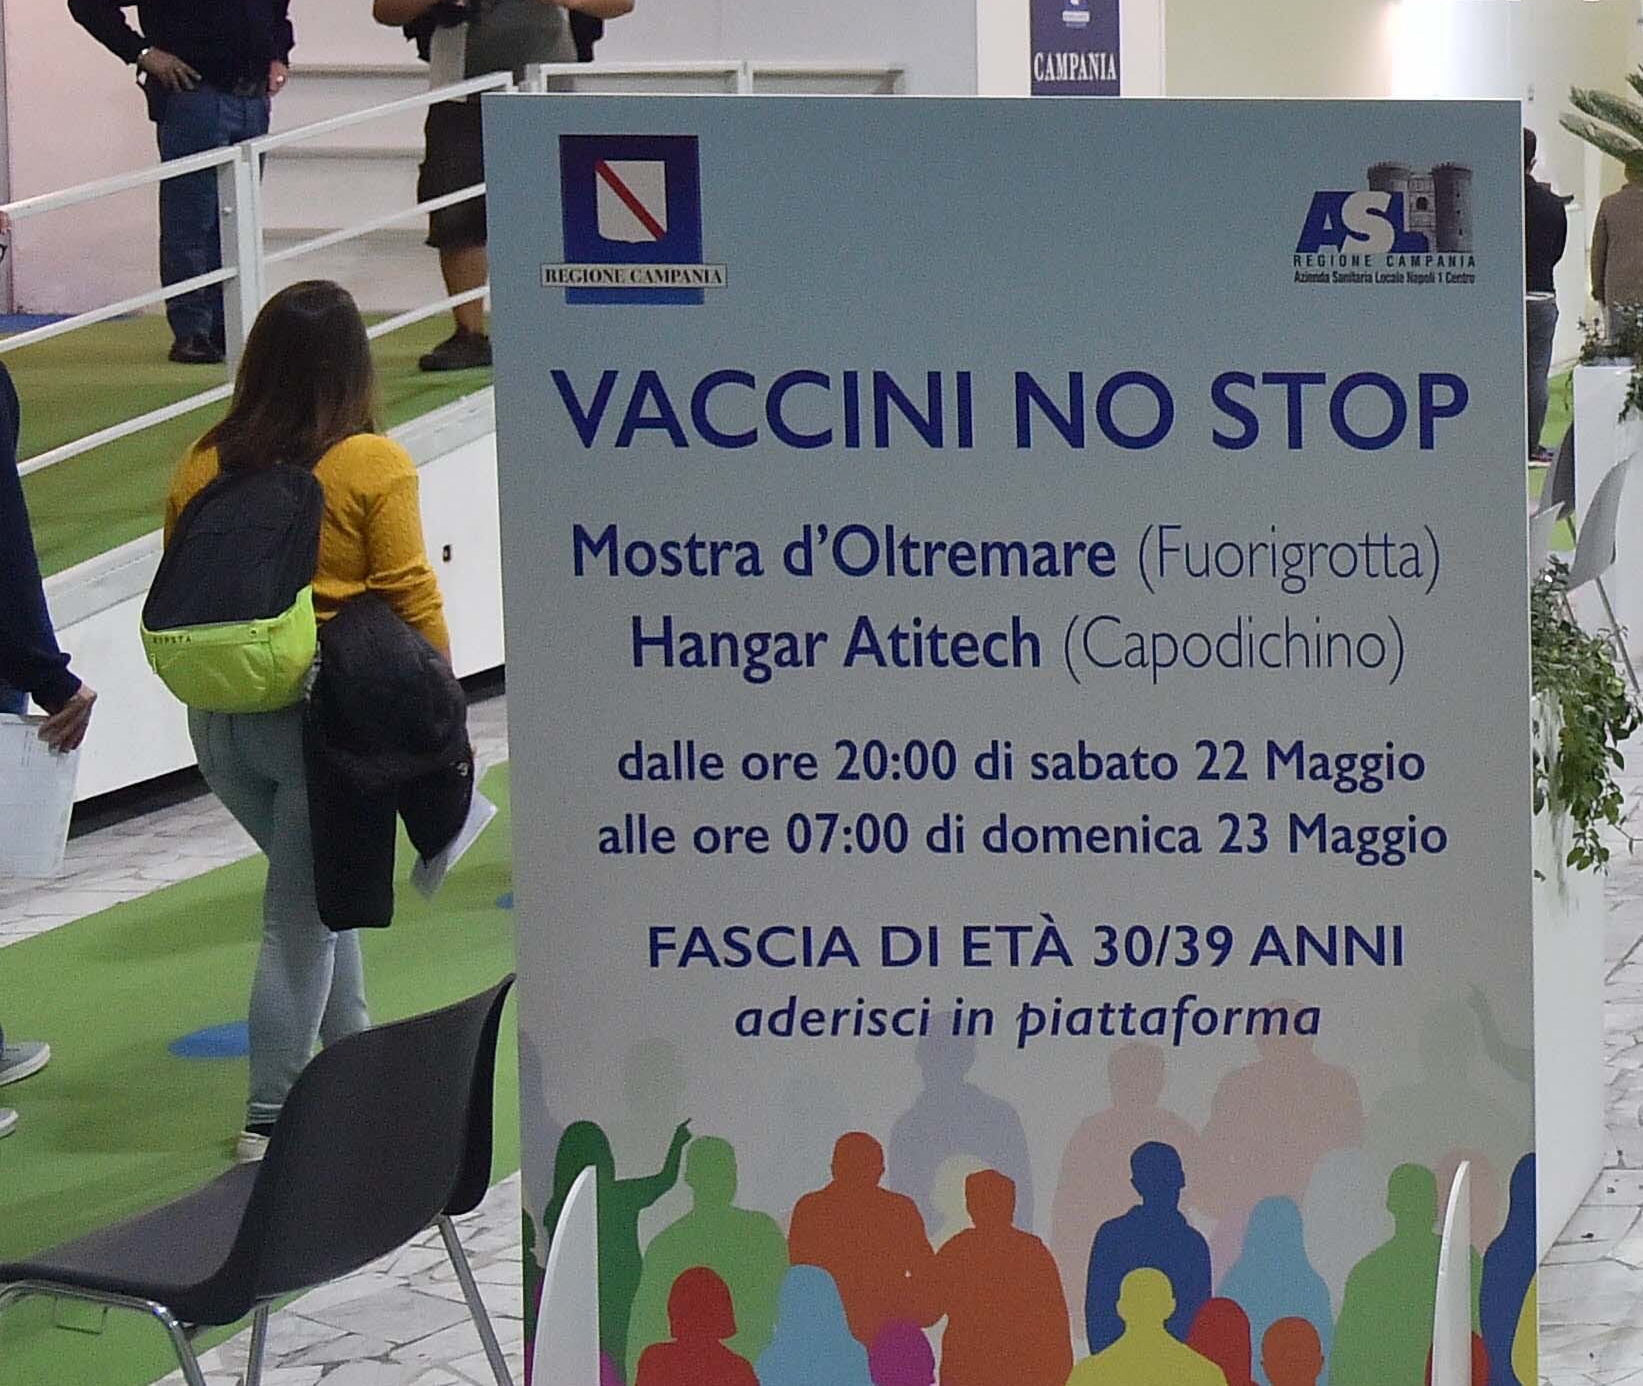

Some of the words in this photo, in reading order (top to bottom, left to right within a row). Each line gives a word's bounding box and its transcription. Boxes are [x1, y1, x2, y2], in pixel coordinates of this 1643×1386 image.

[1033, 52, 1118, 82] CAMPANIA
[1295, 190, 1430, 254] ASL
[545, 268, 626, 284] REGIONE
[629, 269, 723, 285] CAMPANIA
[1293, 254, 1372, 268] REGIONE
[1386, 254, 1477, 268] CAMPANIA
[1294, 270, 1330, 284] Azienda
[1332, 270, 1373, 284] Sanitaria
[1375, 270, 1405, 284] Locale
[1406, 270, 1436, 285] Napoli
[549, 369, 973, 449] VACCINI
[1014, 370, 1175, 450] NO
[1210, 371, 1469, 451] STOP
[572, 523, 765, 577] Mostra
[783, 523, 1116, 578] d'Oltremare
[1138, 524, 1440, 595] (Fuorigrotta)
[632, 615, 829, 685] Hangar
[843, 615, 1041, 668] Atitech
[1064, 614, 1405, 685] (Capodichino)
[617, 739, 724, 781] dalle
[741, 752, 818, 781] ore
[835, 739, 957, 781] 20:00
[974, 739, 1012, 781] di
[1031, 739, 1178, 781] sabato
[1195, 739, 1248, 781] 22
[1266, 739, 1425, 794] Maggio
[598, 813, 676, 855] alle
[693, 825, 769, 855] ore
[786, 812, 909, 854] 07:00
[926, 813, 964, 854] di
[982, 812, 1203, 854] domenica
[1218, 812, 1268, 854] 23
[1289, 812, 1448, 867] Maggio
[649, 925, 860, 968] FASCIA
[881, 925, 939, 967] DI
[963, 913, 1073, 967] ETÀ
[1094, 924, 1233, 967] 30/39
[1249, 925, 1403, 967] ANNI
[735, 995, 931, 1037] aderisci
[952, 997, 994, 1037] in
[1016, 994, 1321, 1049] piattaforma
